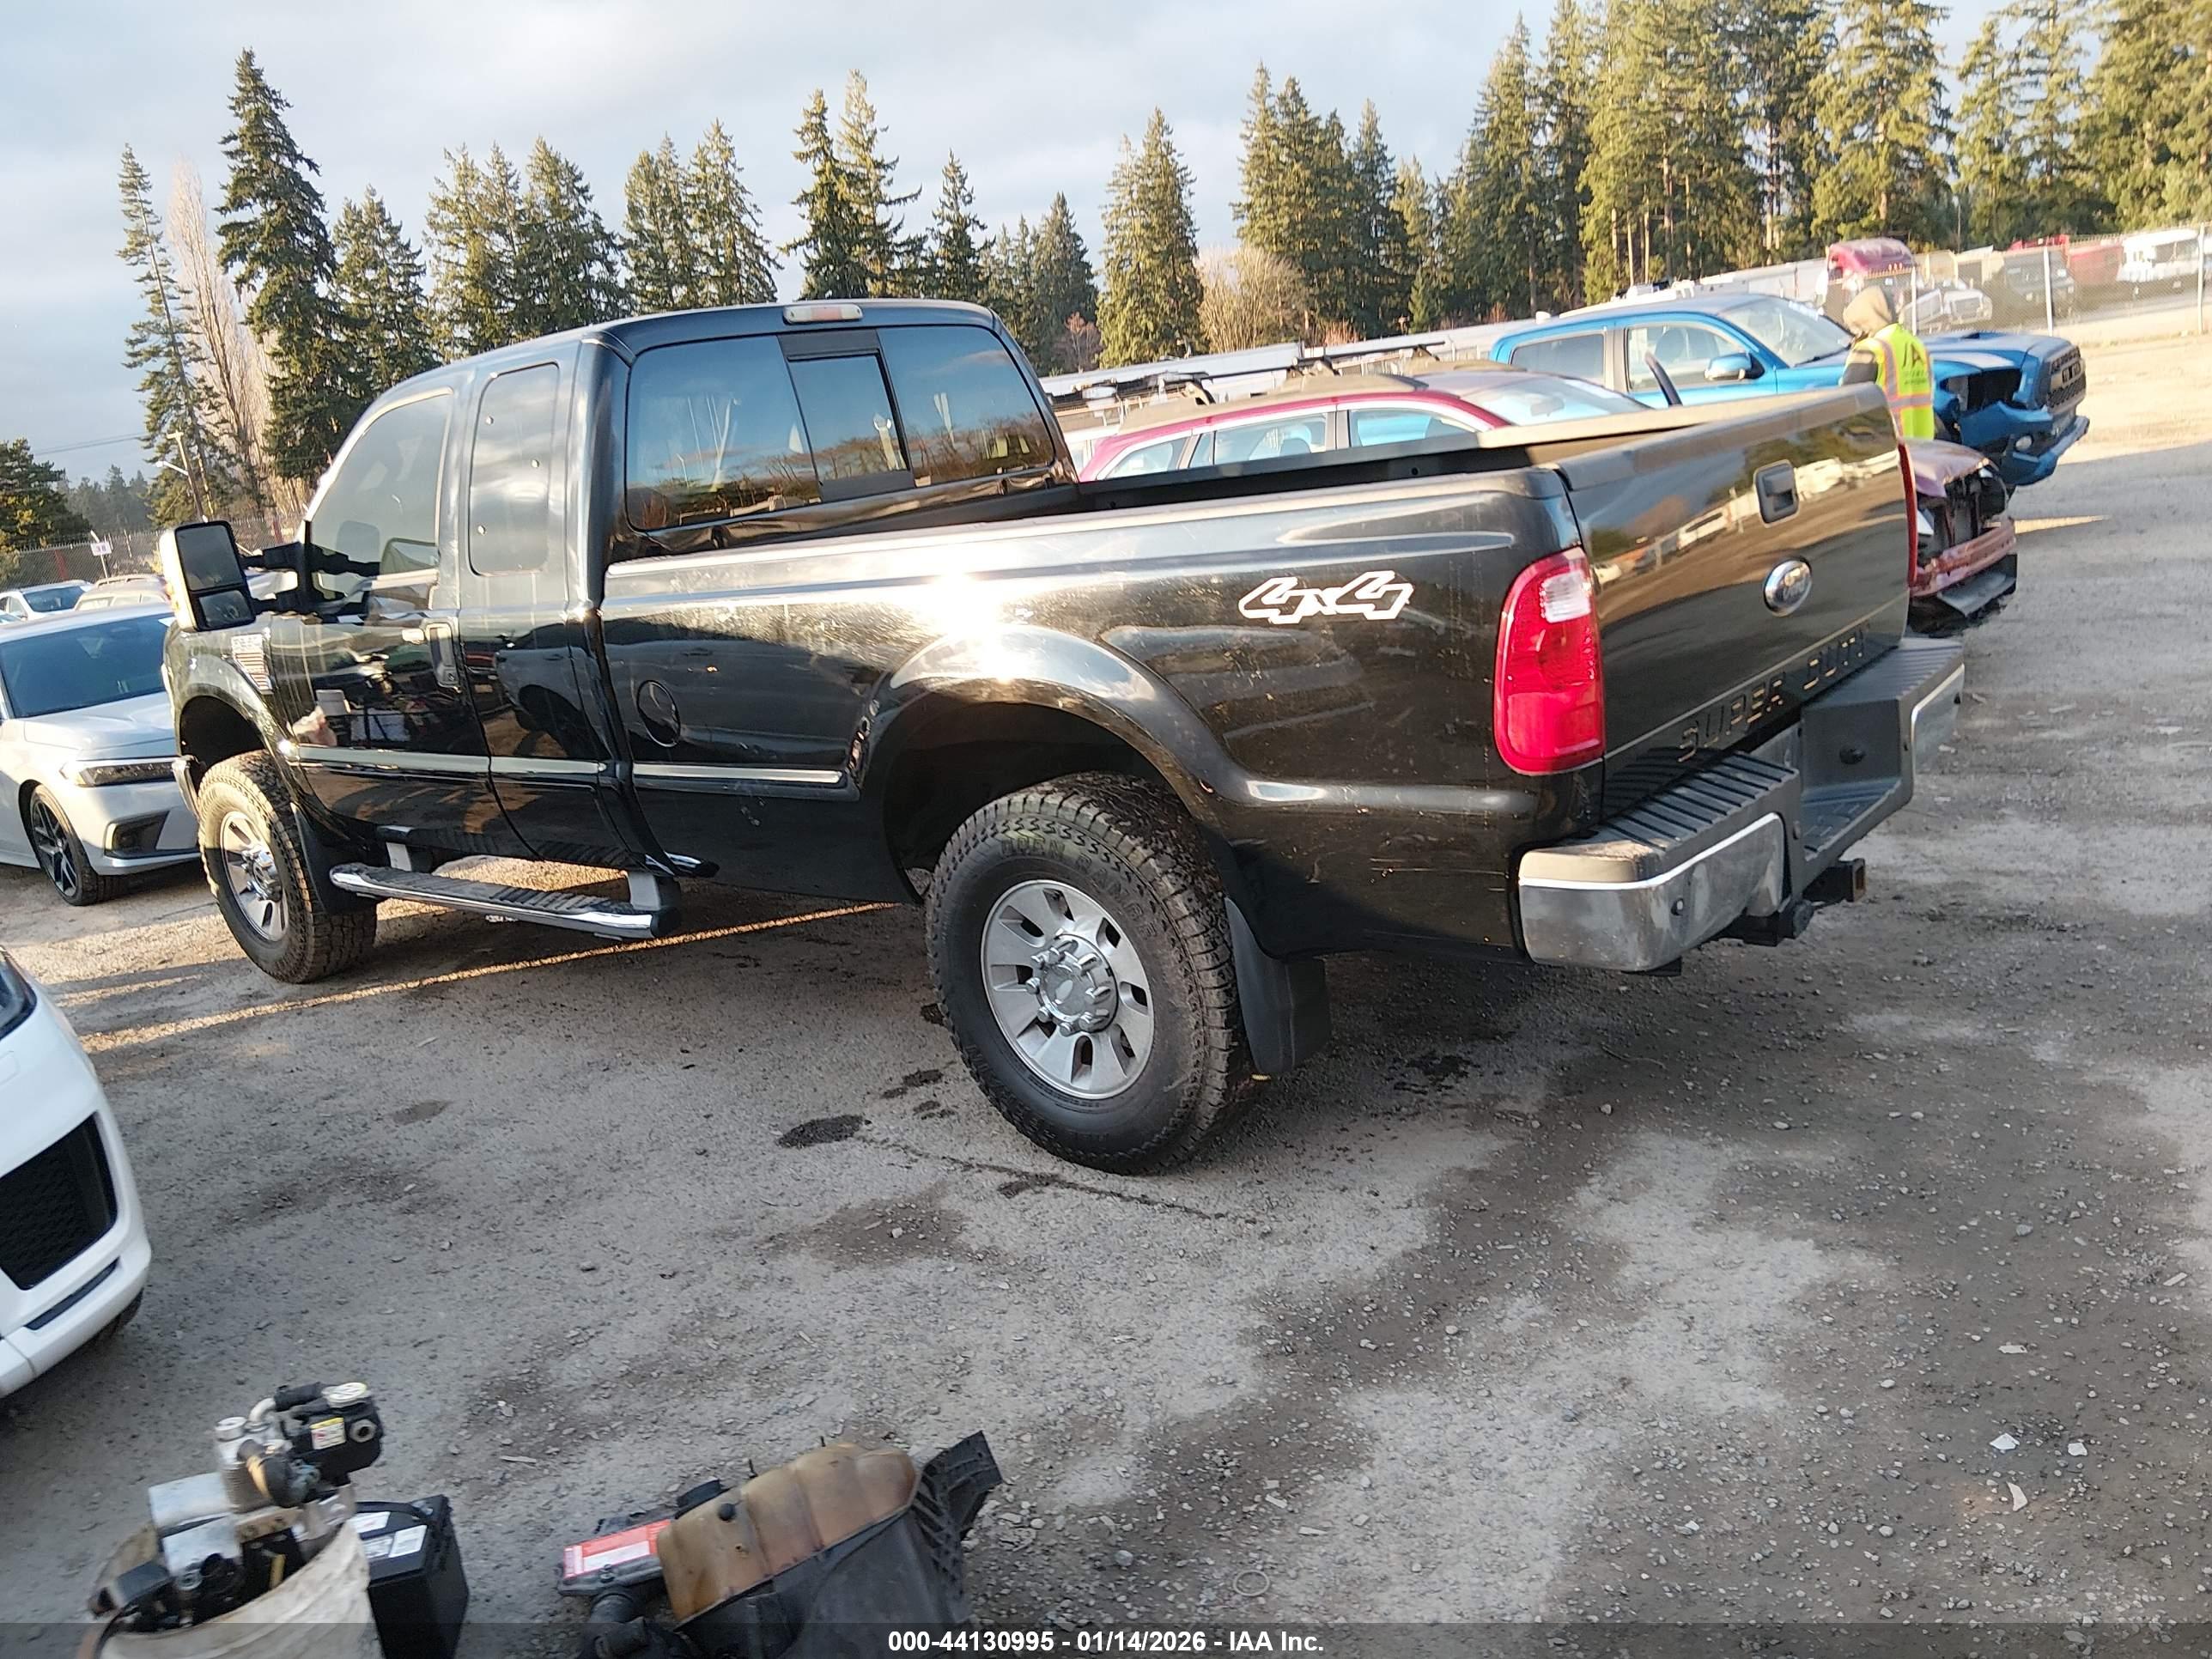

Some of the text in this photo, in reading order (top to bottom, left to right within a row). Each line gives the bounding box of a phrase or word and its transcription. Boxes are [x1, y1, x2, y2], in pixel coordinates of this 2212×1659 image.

[1238, 570, 1414, 624] 4x4
[1677, 671, 1787, 763] SUPER
[1001, 836, 1066, 859] OPEN
